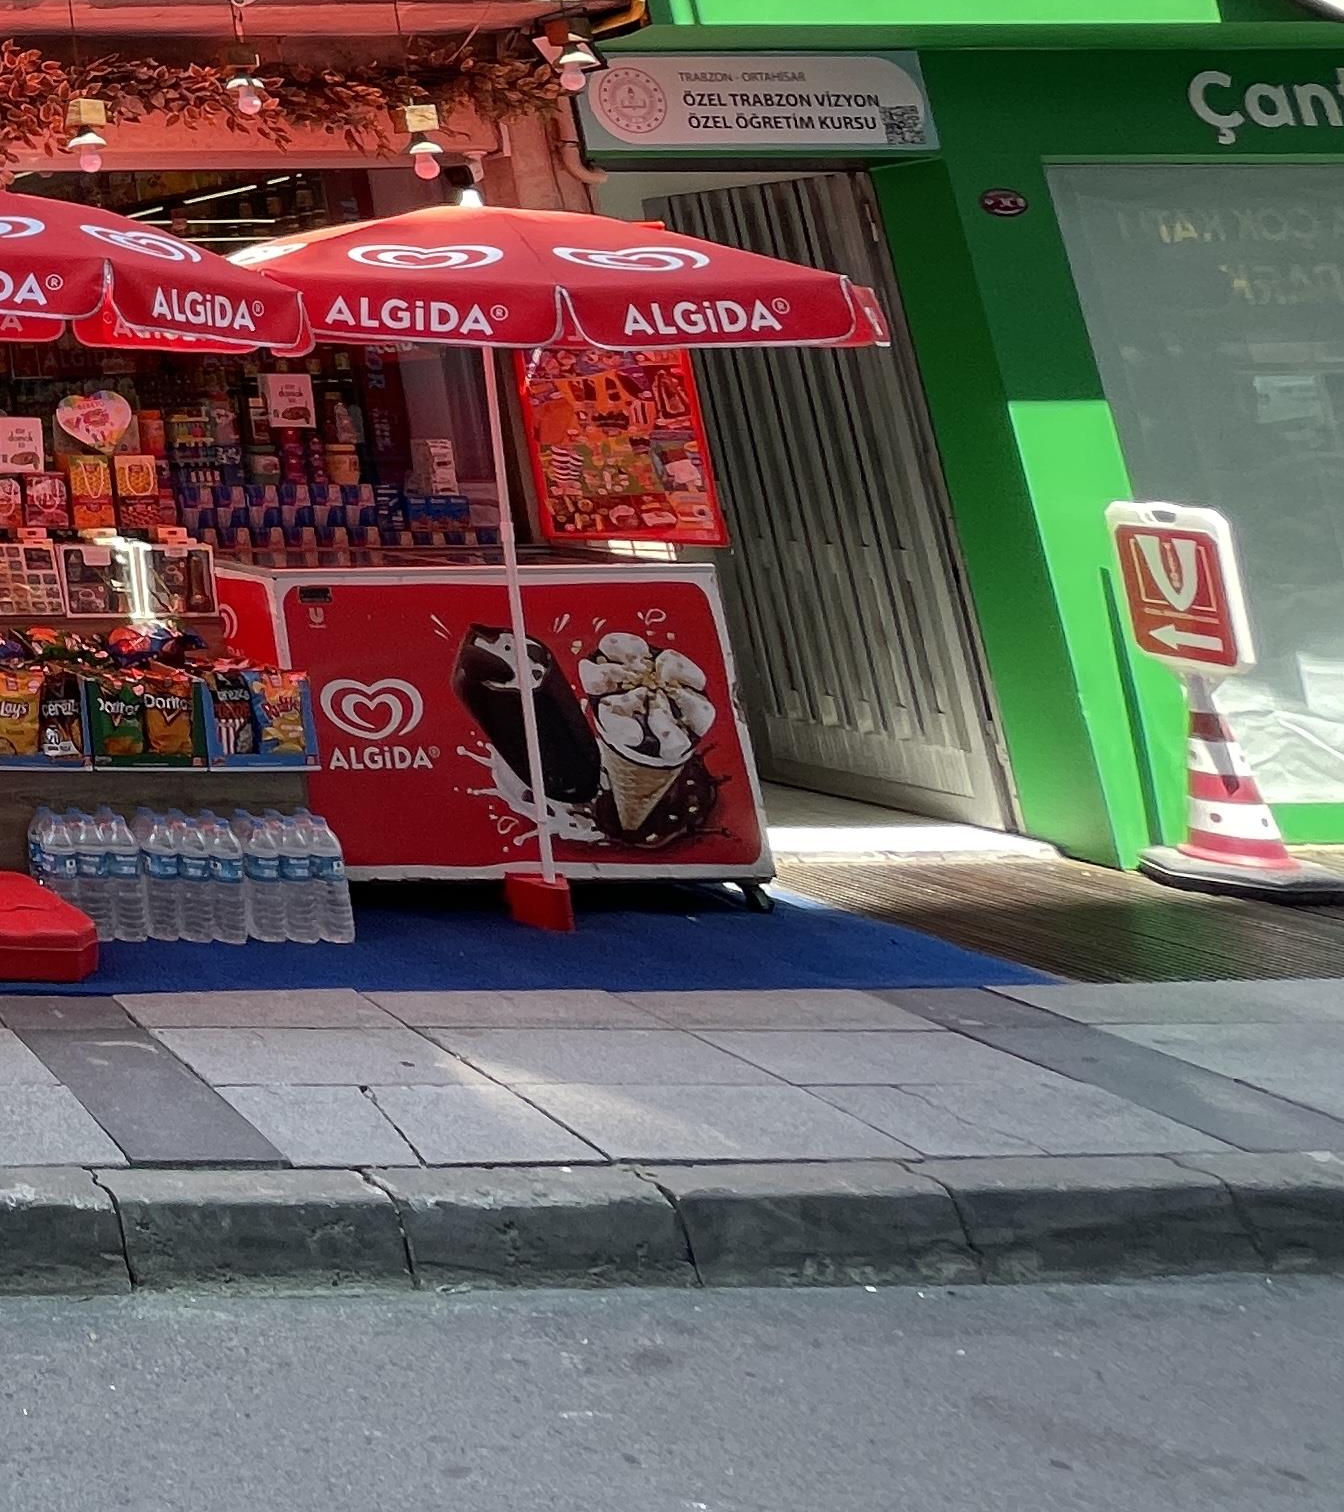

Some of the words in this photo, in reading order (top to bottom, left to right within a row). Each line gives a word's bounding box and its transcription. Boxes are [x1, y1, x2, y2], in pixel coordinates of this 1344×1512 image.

[678, 71, 735, 84] TRABZON
[682, 90, 728, 109] ÖZEL
[729, 92, 814, 109] TRABZON
[814, 90, 881, 109] VİZYON
[687, 113, 733, 131] ÖZEL
[735, 112, 815, 131] ÖĞRETİM
[818, 116, 878, 131] KURSU
[0, 700, 29, 719] Lay's
